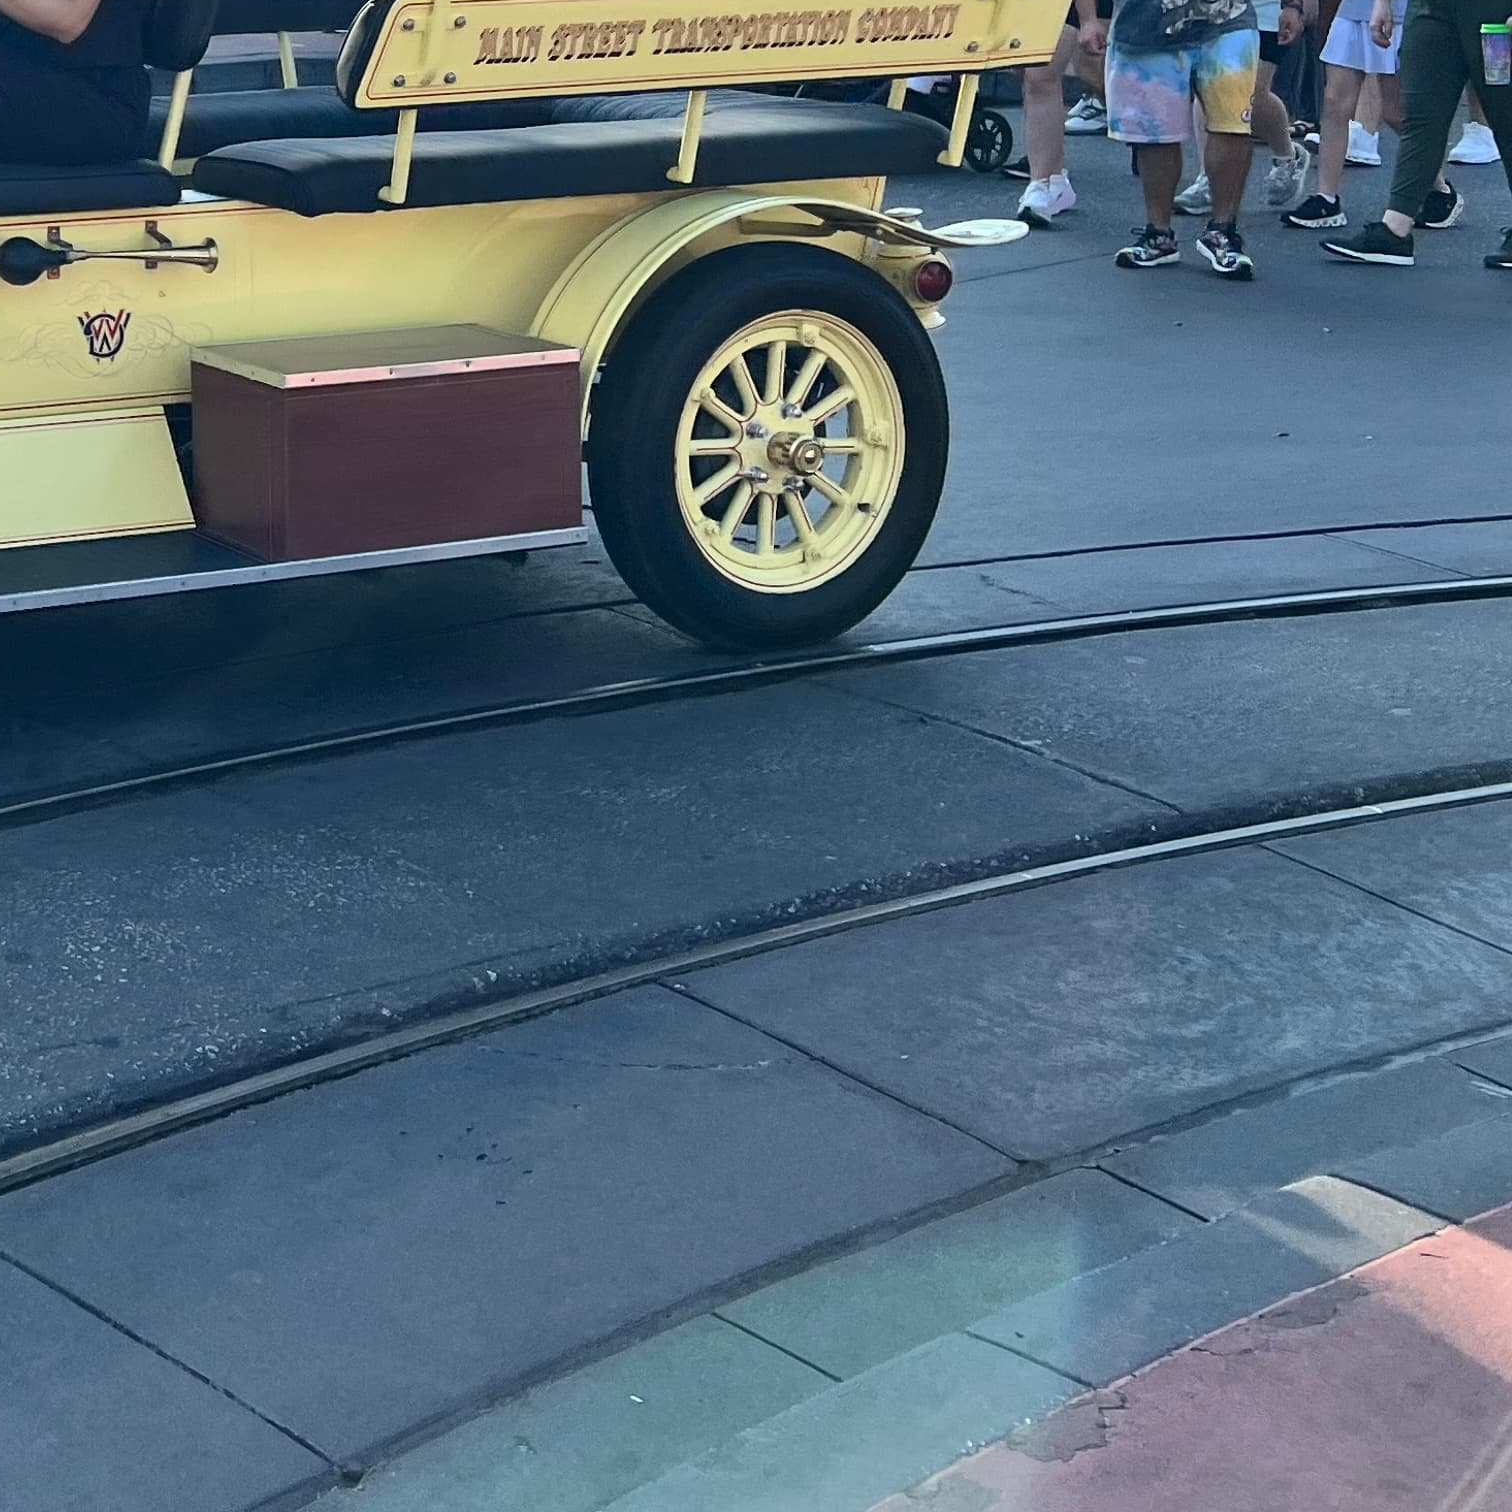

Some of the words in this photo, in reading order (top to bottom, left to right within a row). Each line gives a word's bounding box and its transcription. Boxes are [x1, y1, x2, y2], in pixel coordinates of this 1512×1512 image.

[473, 24, 545, 65] MAIN
[548, 19, 647, 62] STREET
[651, 8, 852, 55] TRANSPORTATION
[855, 3, 962, 44] COMPANY
